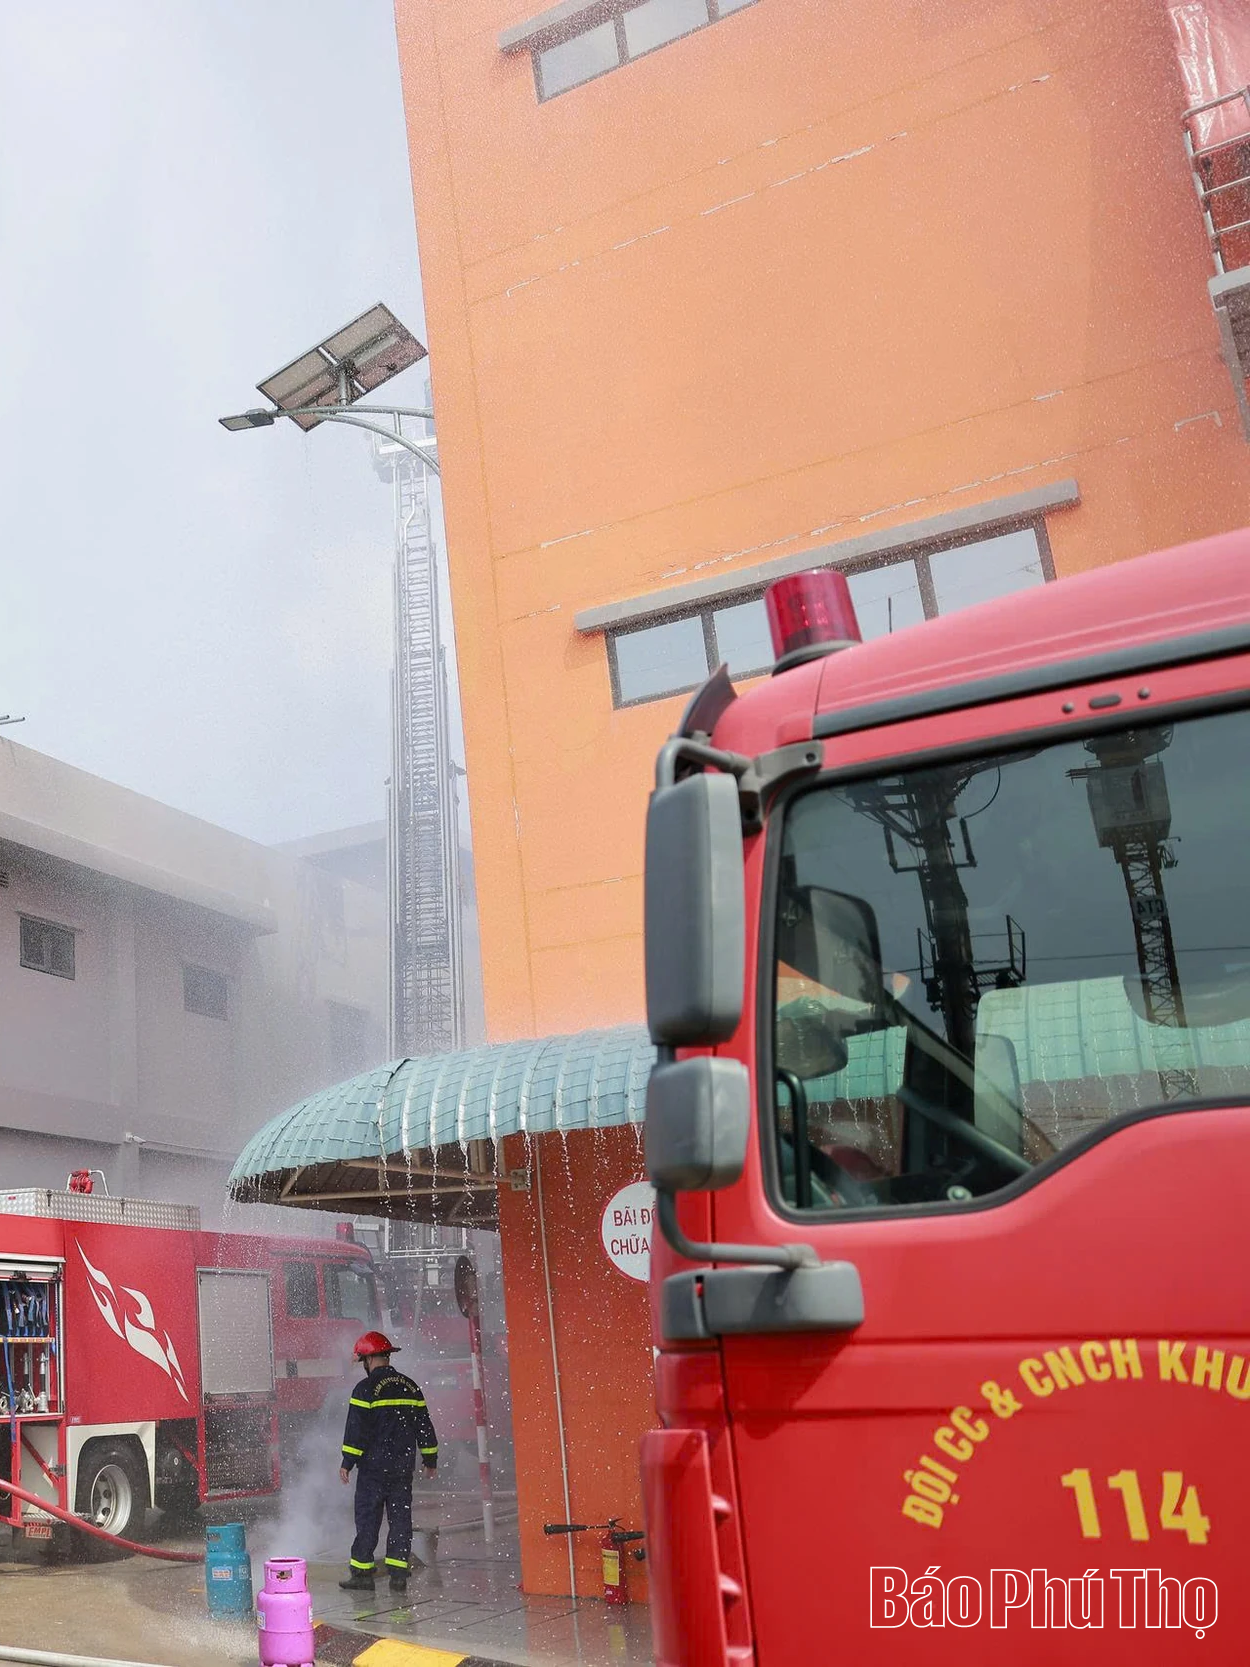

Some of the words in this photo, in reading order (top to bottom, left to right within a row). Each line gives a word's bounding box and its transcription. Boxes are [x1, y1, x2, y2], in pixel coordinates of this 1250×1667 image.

[613, 1205, 637, 1227] BÃI
[610, 1233, 651, 1255] CHỮA
[902, 1455, 960, 1529] ĐỘI
[933, 1405, 990, 1462] CC
[980, 1380, 1023, 1419] &
[1018, 1338, 1143, 1398] CNCH
[1157, 1340, 1250, 1400] KHU
[1061, 1468, 1211, 1545] 114
